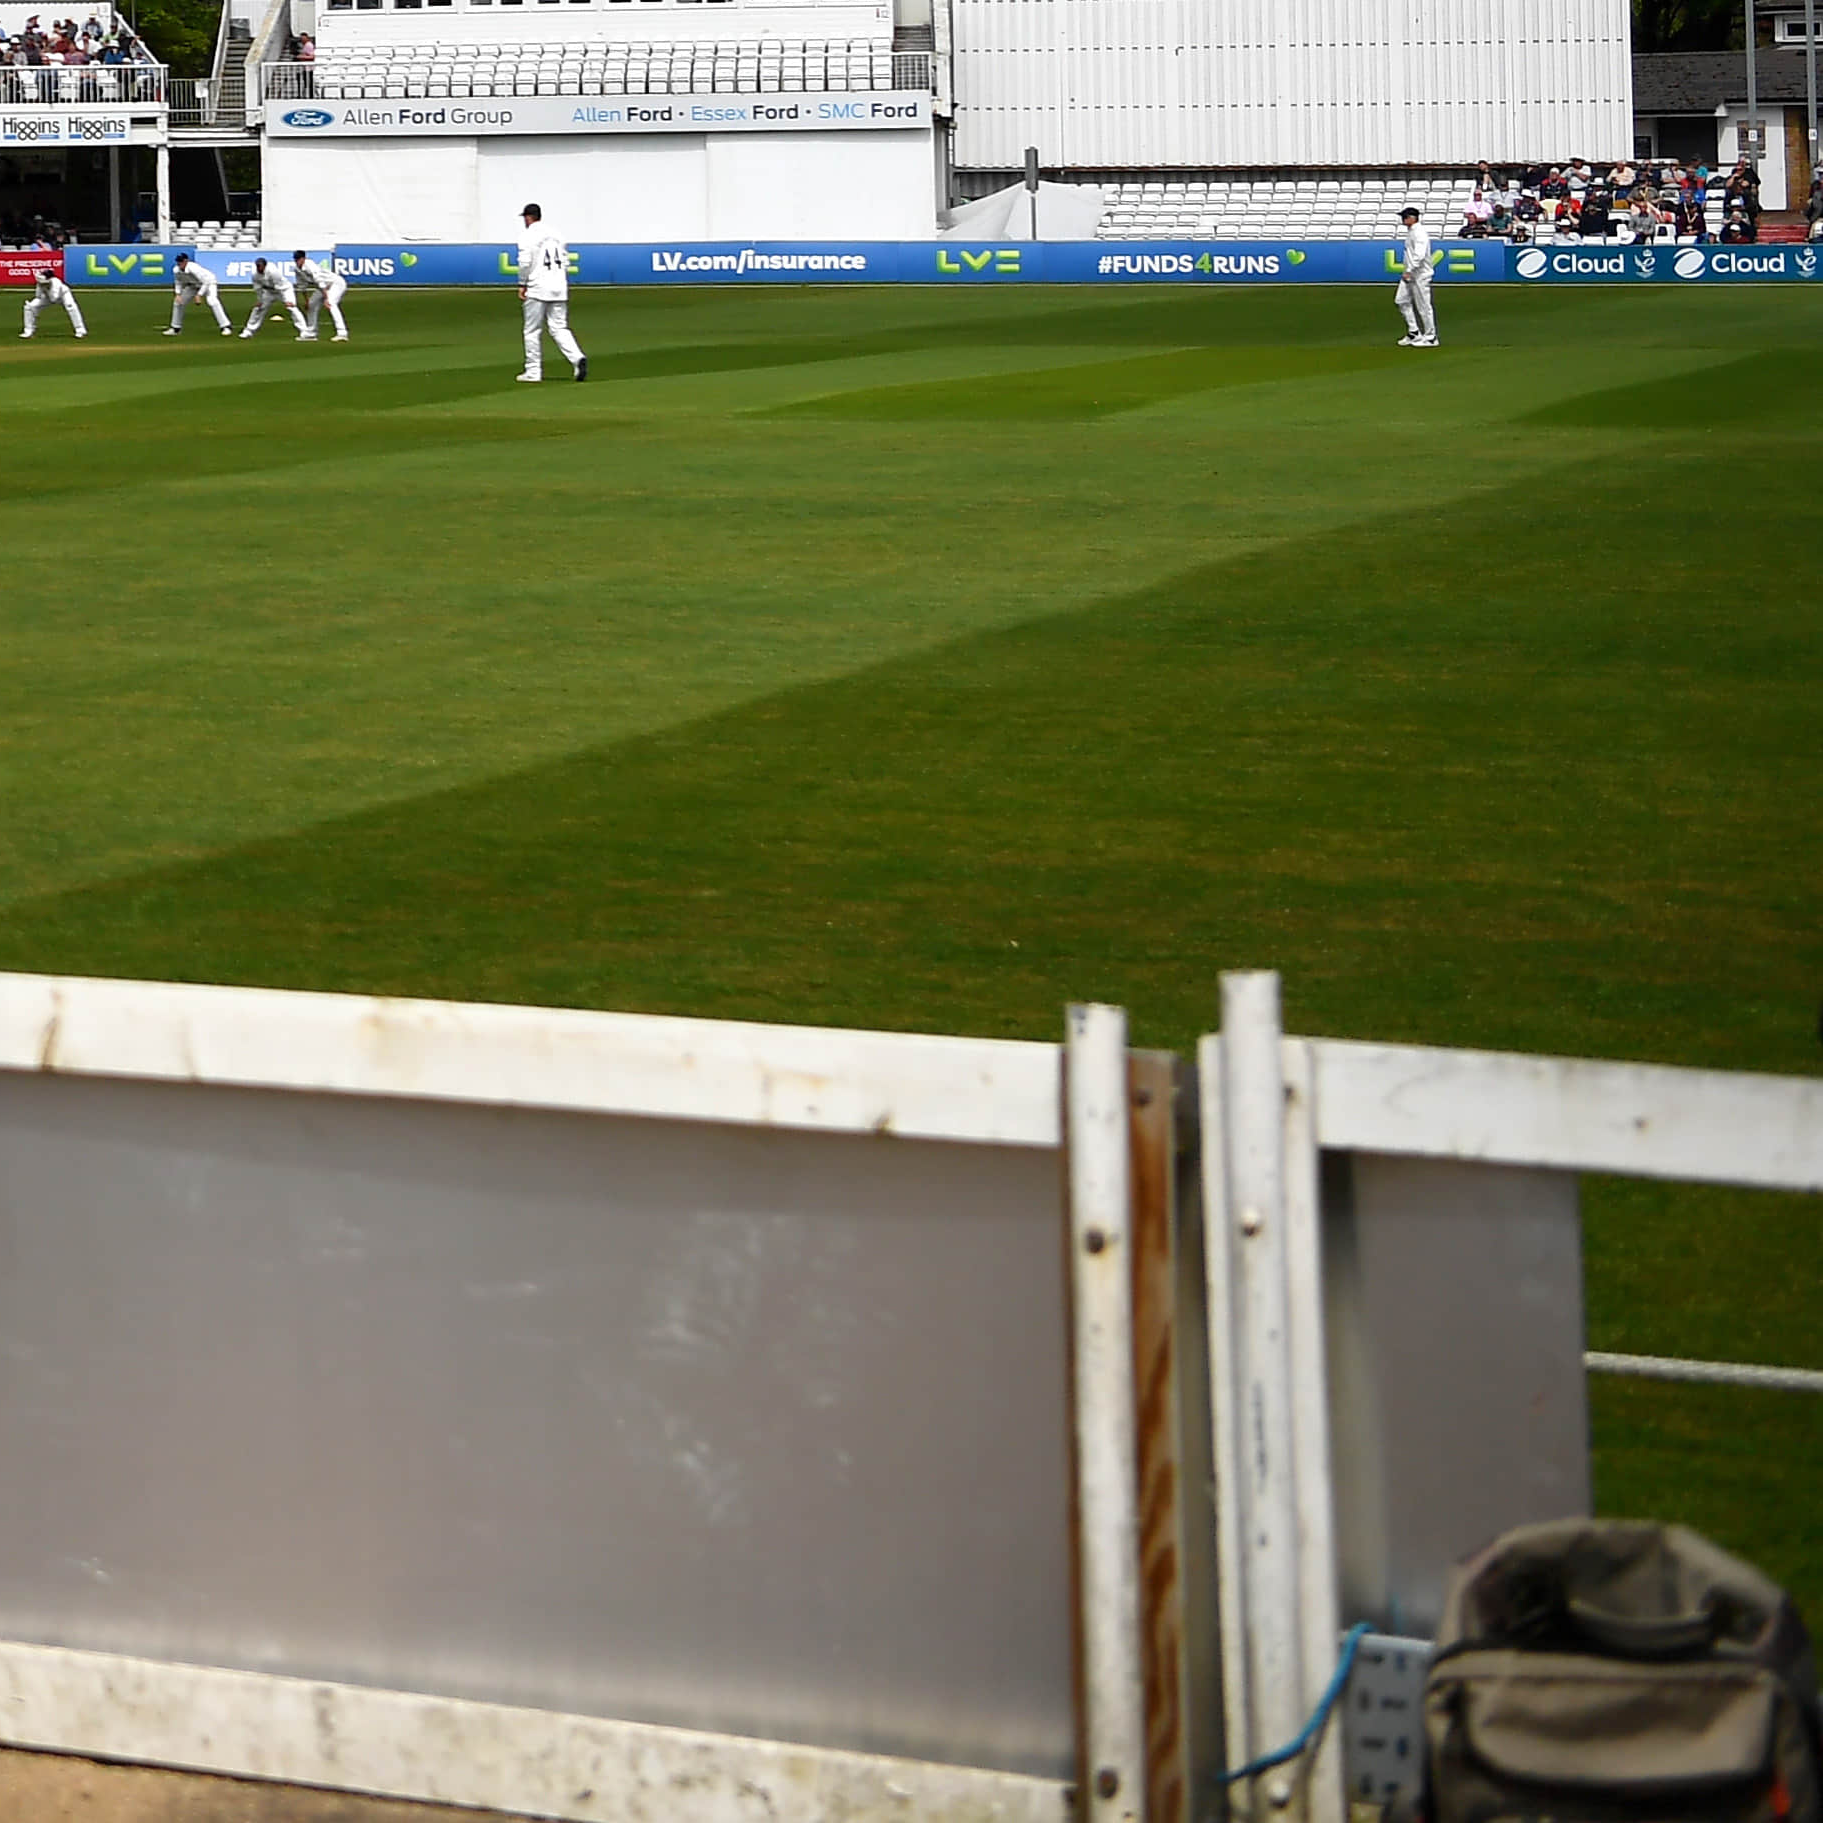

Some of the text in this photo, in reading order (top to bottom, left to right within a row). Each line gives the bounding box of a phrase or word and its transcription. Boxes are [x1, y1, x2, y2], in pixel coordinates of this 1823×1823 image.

[291, 110, 324, 126] Ford
[343, 108, 513, 127] Allen Ford Group
[572, 102, 918, 122] Allen Ford Essex Ford SMC Ford
[3, 118, 61, 140] Higgins
[68, 117, 126, 140] Higgins
[0, 259, 63, 268] THE PRESERVE OF
[86, 253, 164, 275] LV=
[543, 247, 562, 271] 44
[652, 249, 866, 273] LV.com/insurance
[936, 250, 1021, 273] LV=
[1097, 252, 1280, 274] #FUNDS4RUNS
[1552, 251, 1625, 274] Cloud
[1711, 251, 1785, 274] Cloud
